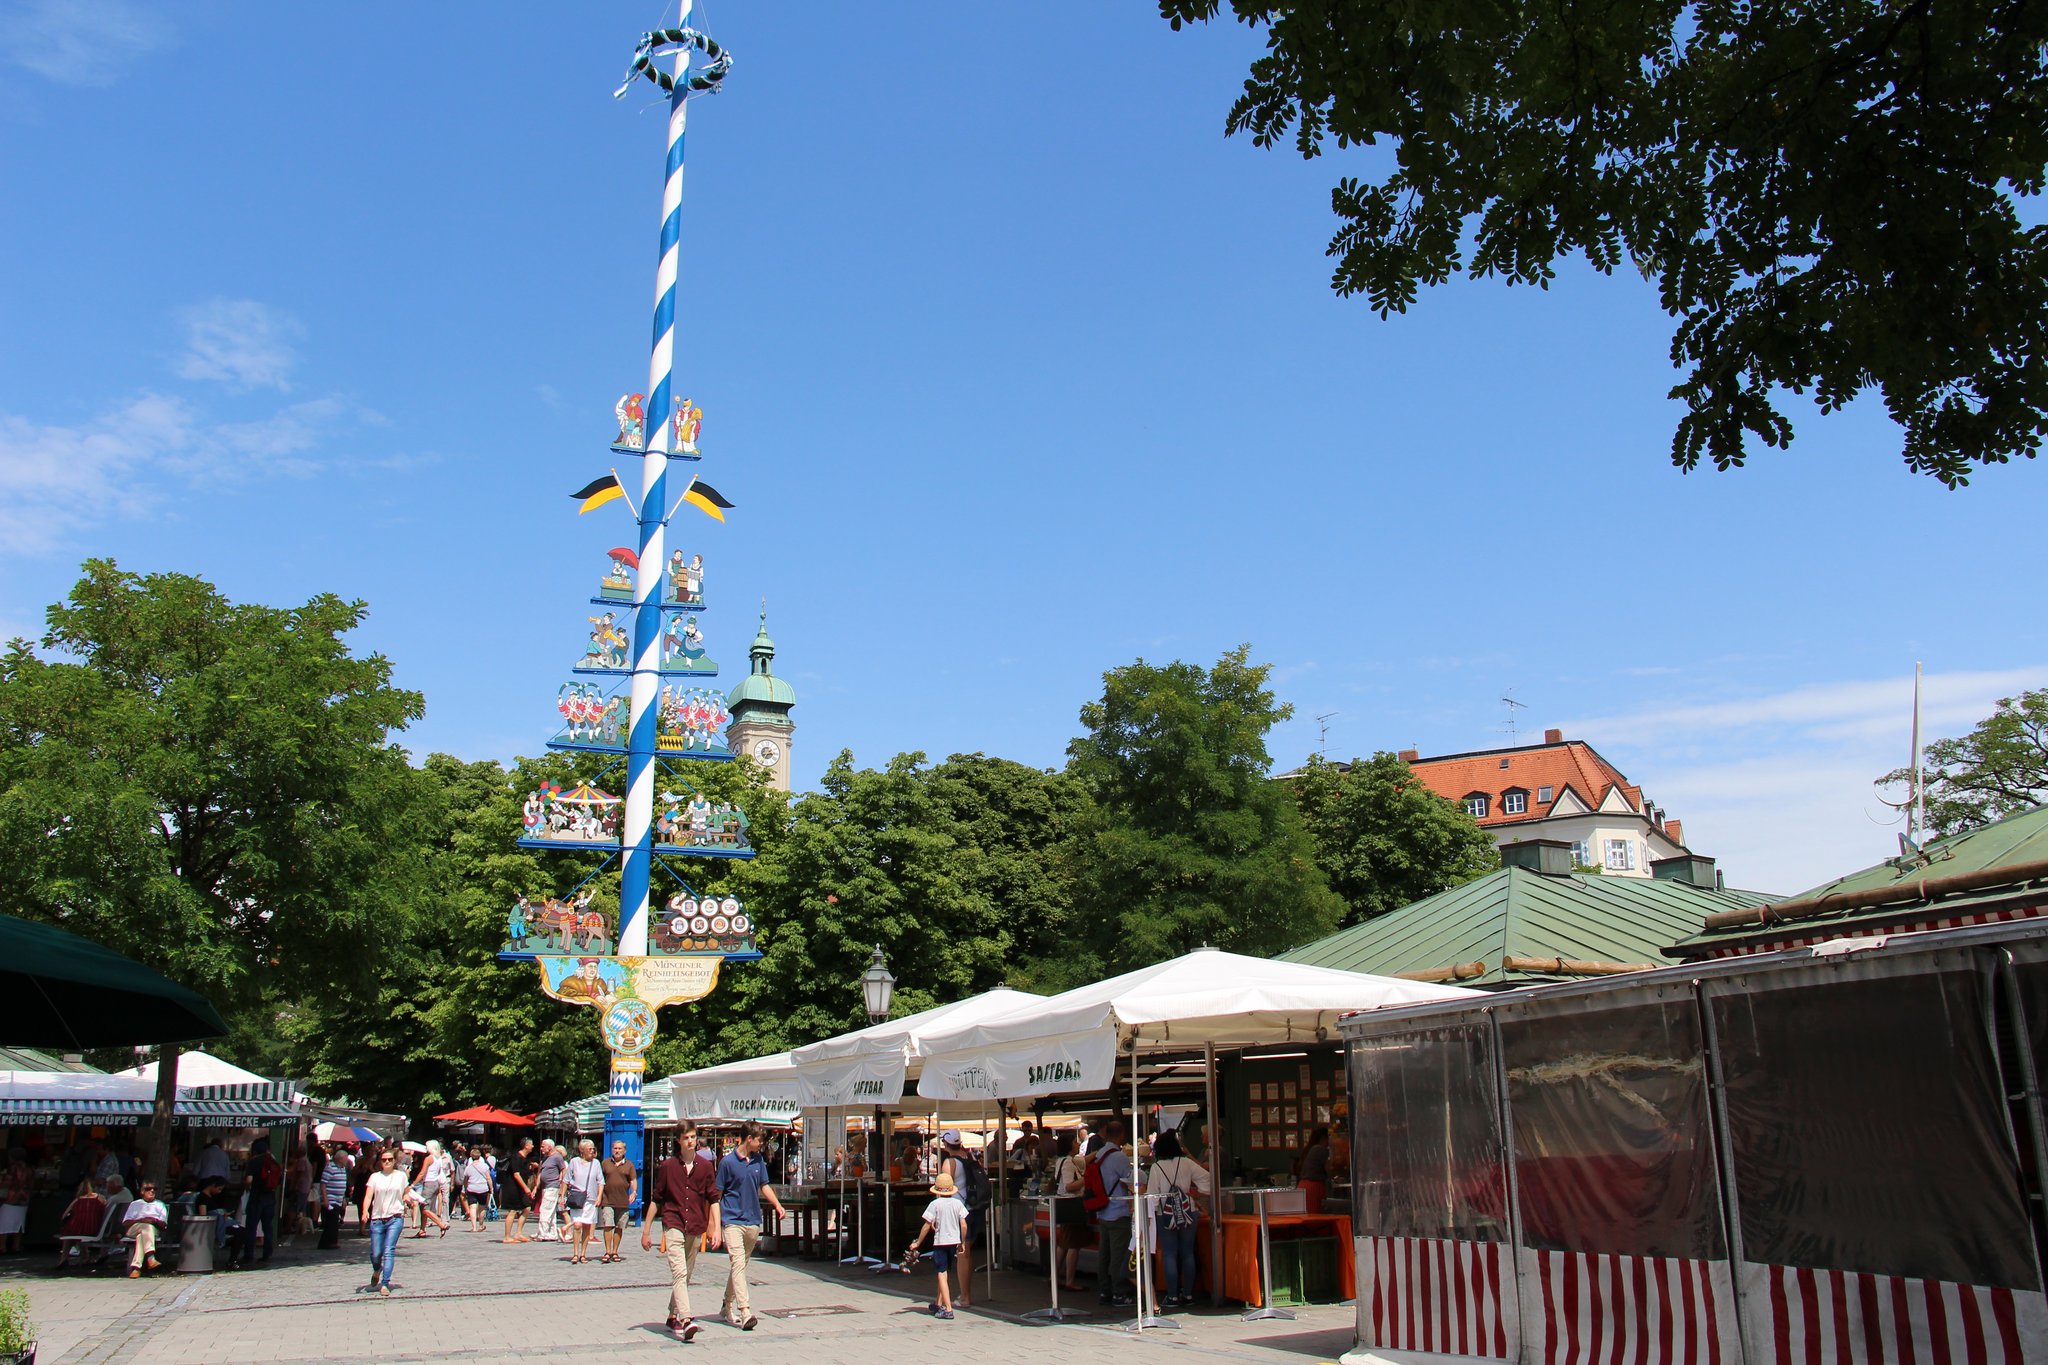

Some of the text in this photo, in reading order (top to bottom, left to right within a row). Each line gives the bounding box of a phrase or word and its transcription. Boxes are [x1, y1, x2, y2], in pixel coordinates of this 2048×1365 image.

[653, 960, 703, 969] MÜNCHNER
[642, 968, 711, 979] REINHEITSGEBOT
[1029, 1060, 1081, 1085] SAFTBAR
[0, 1113, 138, 1126] räuter & Gewürze
[188, 1116, 203, 1127] DIE
[204, 1116, 234, 1127] SAURE
[235, 1116, 259, 1127] ECKE
